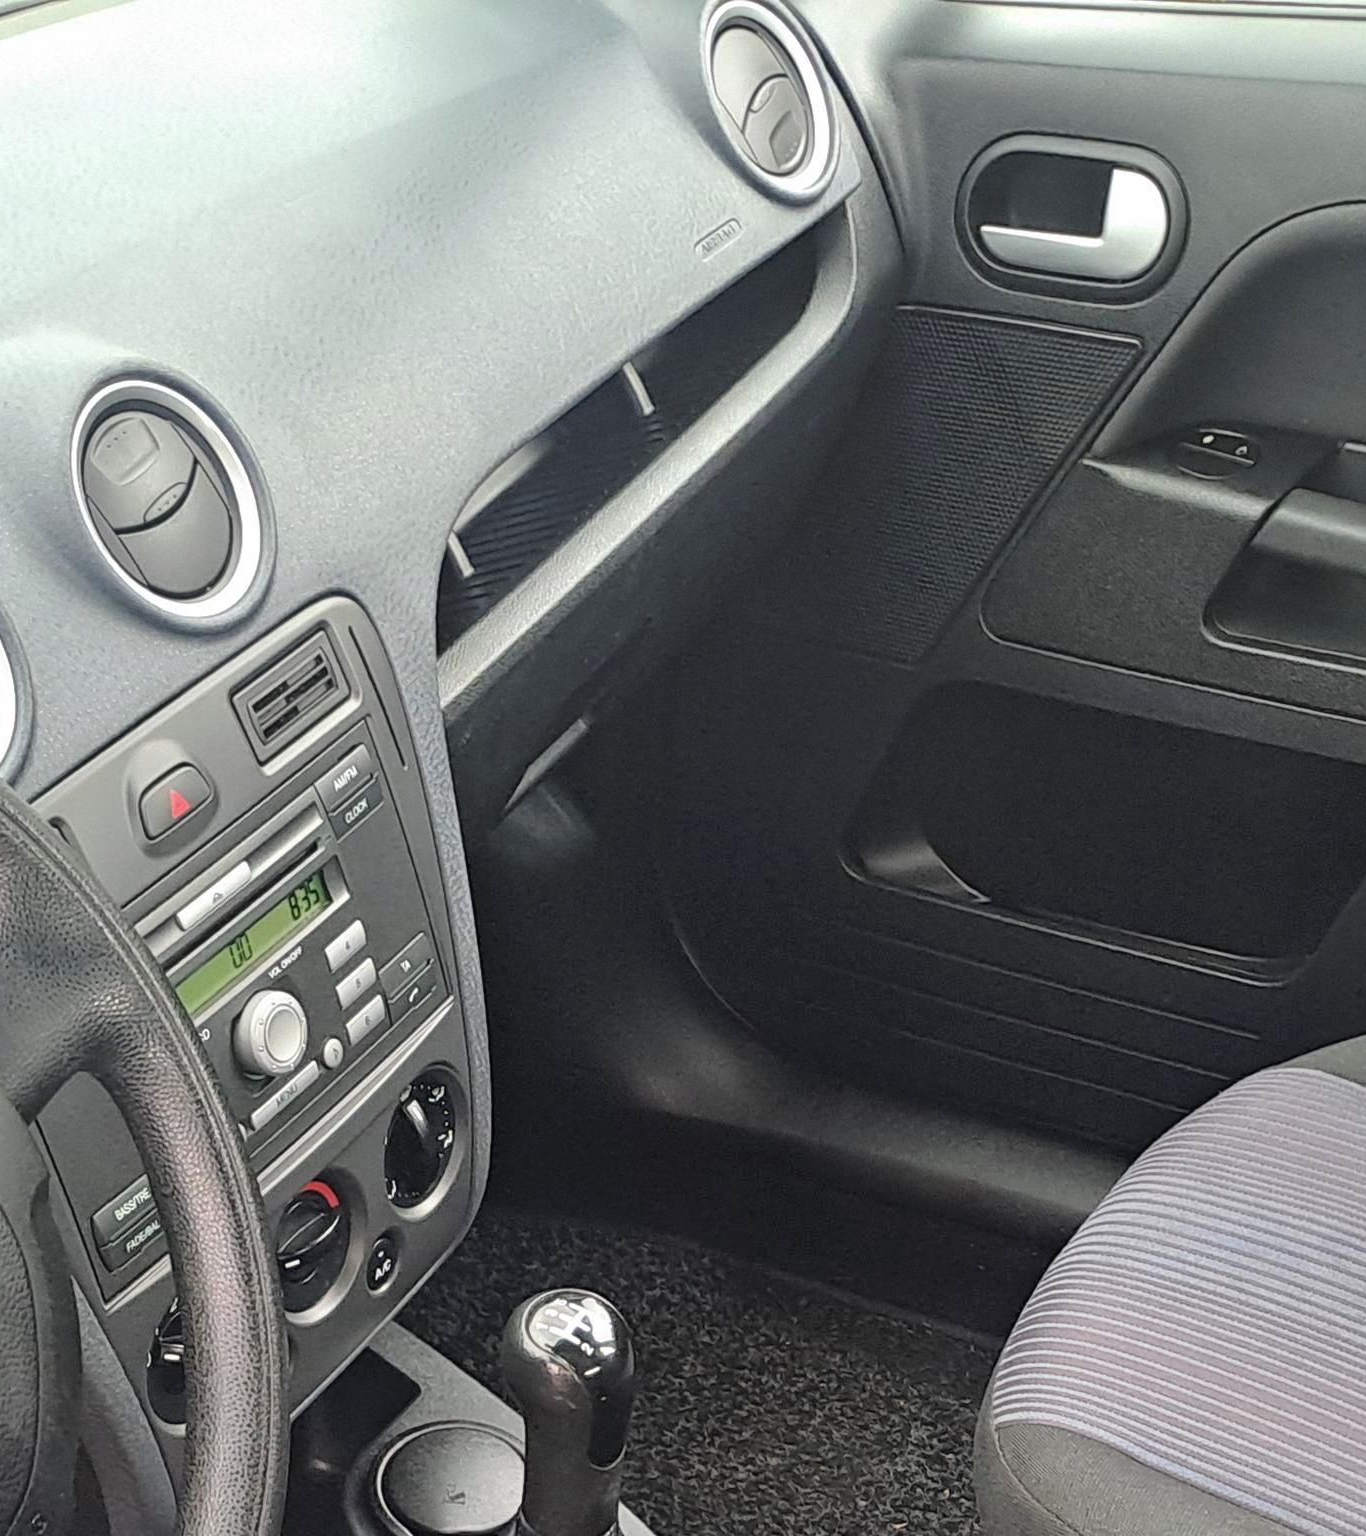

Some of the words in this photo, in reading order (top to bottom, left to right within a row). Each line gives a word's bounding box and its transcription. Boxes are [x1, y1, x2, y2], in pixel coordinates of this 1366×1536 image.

[332, 764, 359, 793] AM/FM
[344, 797, 369, 824] CLOCK
[267, 966, 282, 979] VOL
[280, 945, 303, 969] ON/OFF
[399, 960, 412, 972] TA
[126, 1219, 161, 1253] FADE/BAL
[375, 1258, 392, 1281] A/C
[580, 1342, 595, 1356] 2
